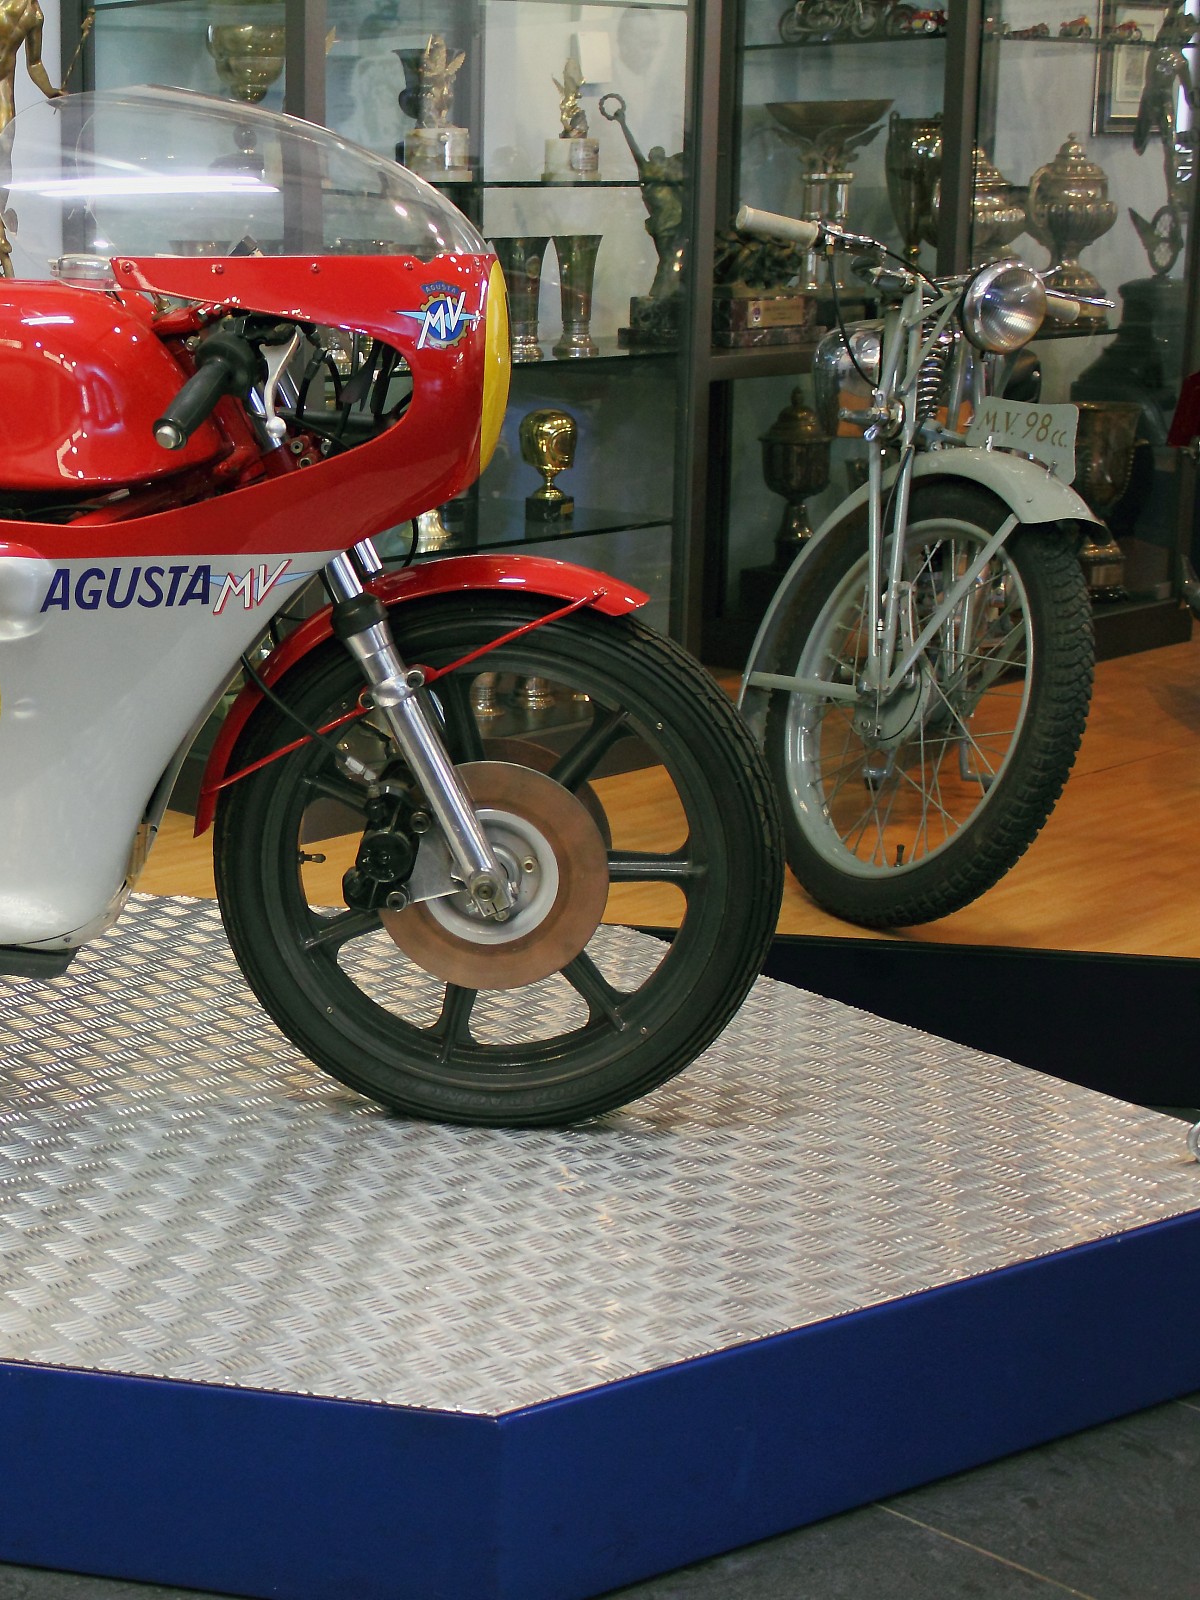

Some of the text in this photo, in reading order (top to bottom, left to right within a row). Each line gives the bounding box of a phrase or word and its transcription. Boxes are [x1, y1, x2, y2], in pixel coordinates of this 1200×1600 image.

[424, 284, 457, 294] AGUSTA
[416, 291, 466, 350] MV
[1022, 411, 1053, 443] 98
[40, 558, 293, 616] AGUSTA MV
